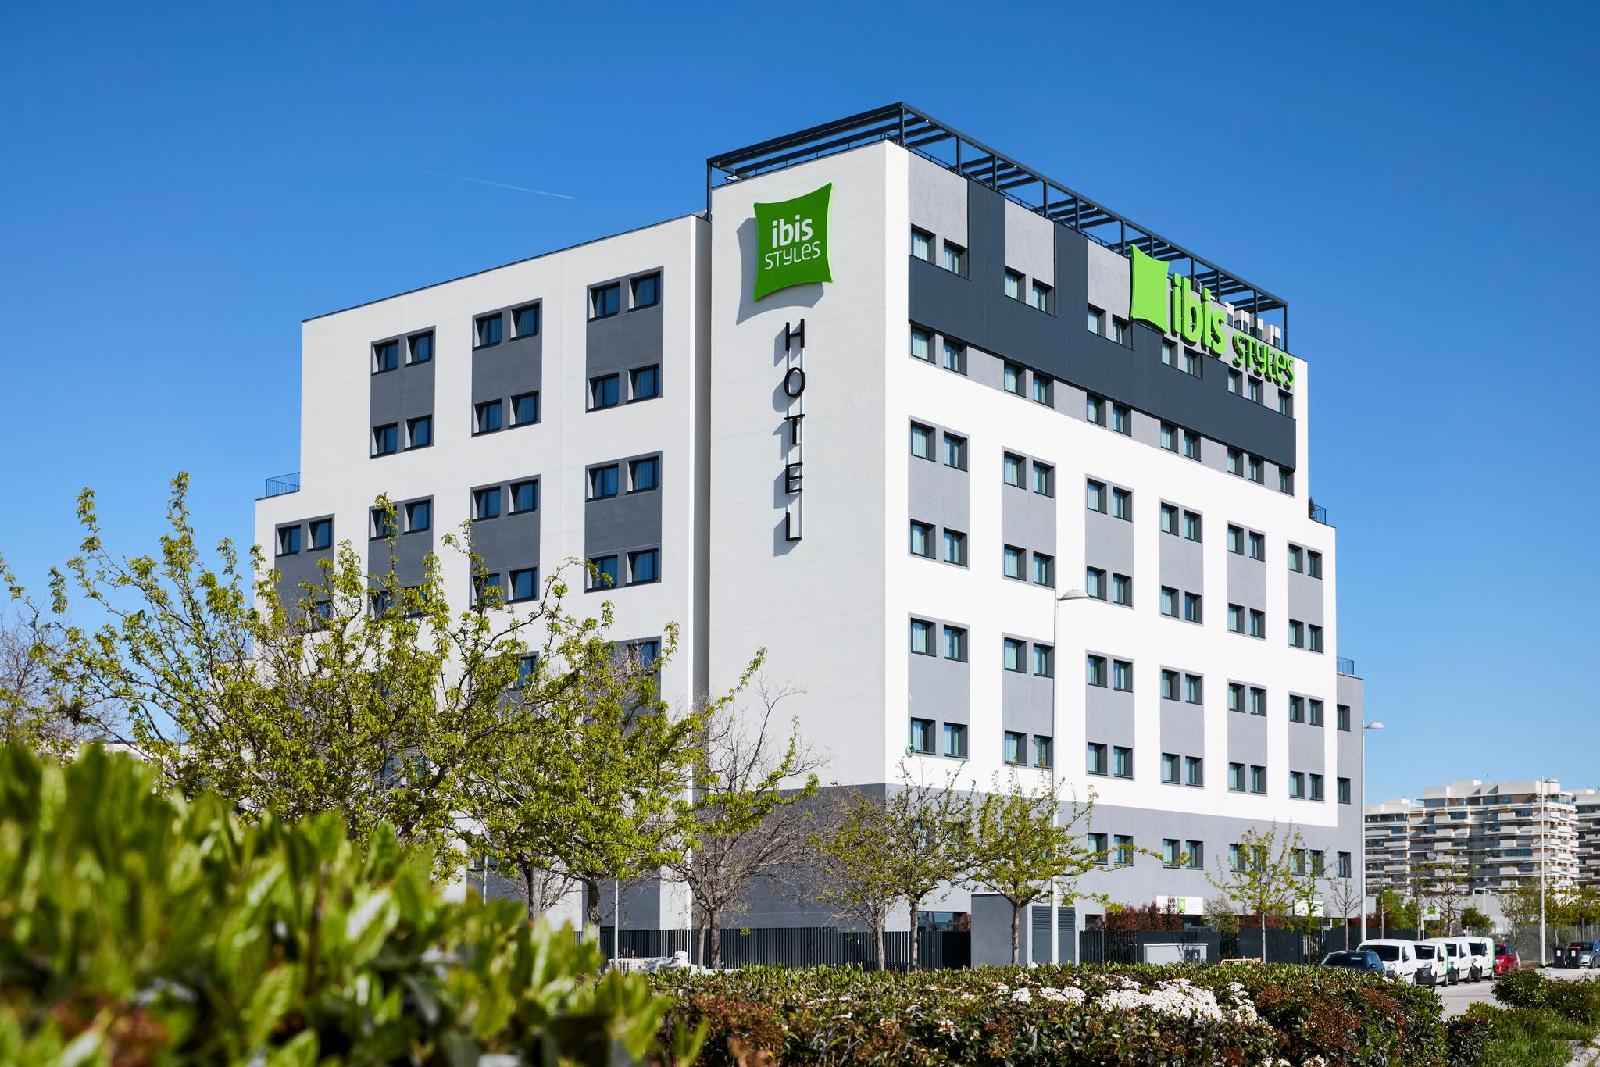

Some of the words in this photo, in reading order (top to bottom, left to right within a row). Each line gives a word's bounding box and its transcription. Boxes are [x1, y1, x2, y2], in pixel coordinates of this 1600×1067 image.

[772, 214, 814, 248] ibis
[1172, 273, 1227, 356] ibis
[784, 318, 805, 541] HOTEL
